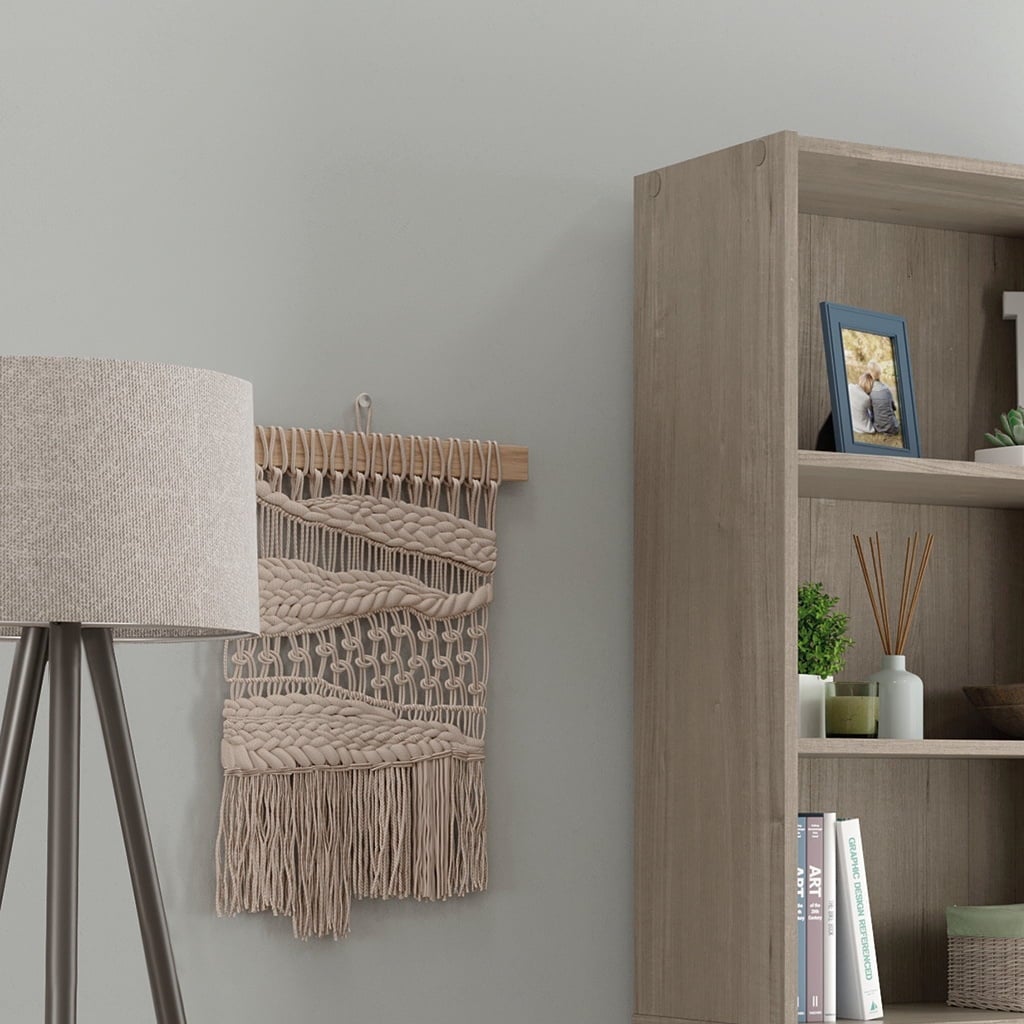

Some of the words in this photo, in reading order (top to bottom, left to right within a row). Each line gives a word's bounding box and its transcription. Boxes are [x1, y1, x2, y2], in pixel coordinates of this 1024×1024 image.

[848, 837, 860, 880] GRAPHIC
[809, 866, 821, 898] ART
[854, 882, 865, 917] DESIGN
[859, 919, 873, 980] REFERENCED
